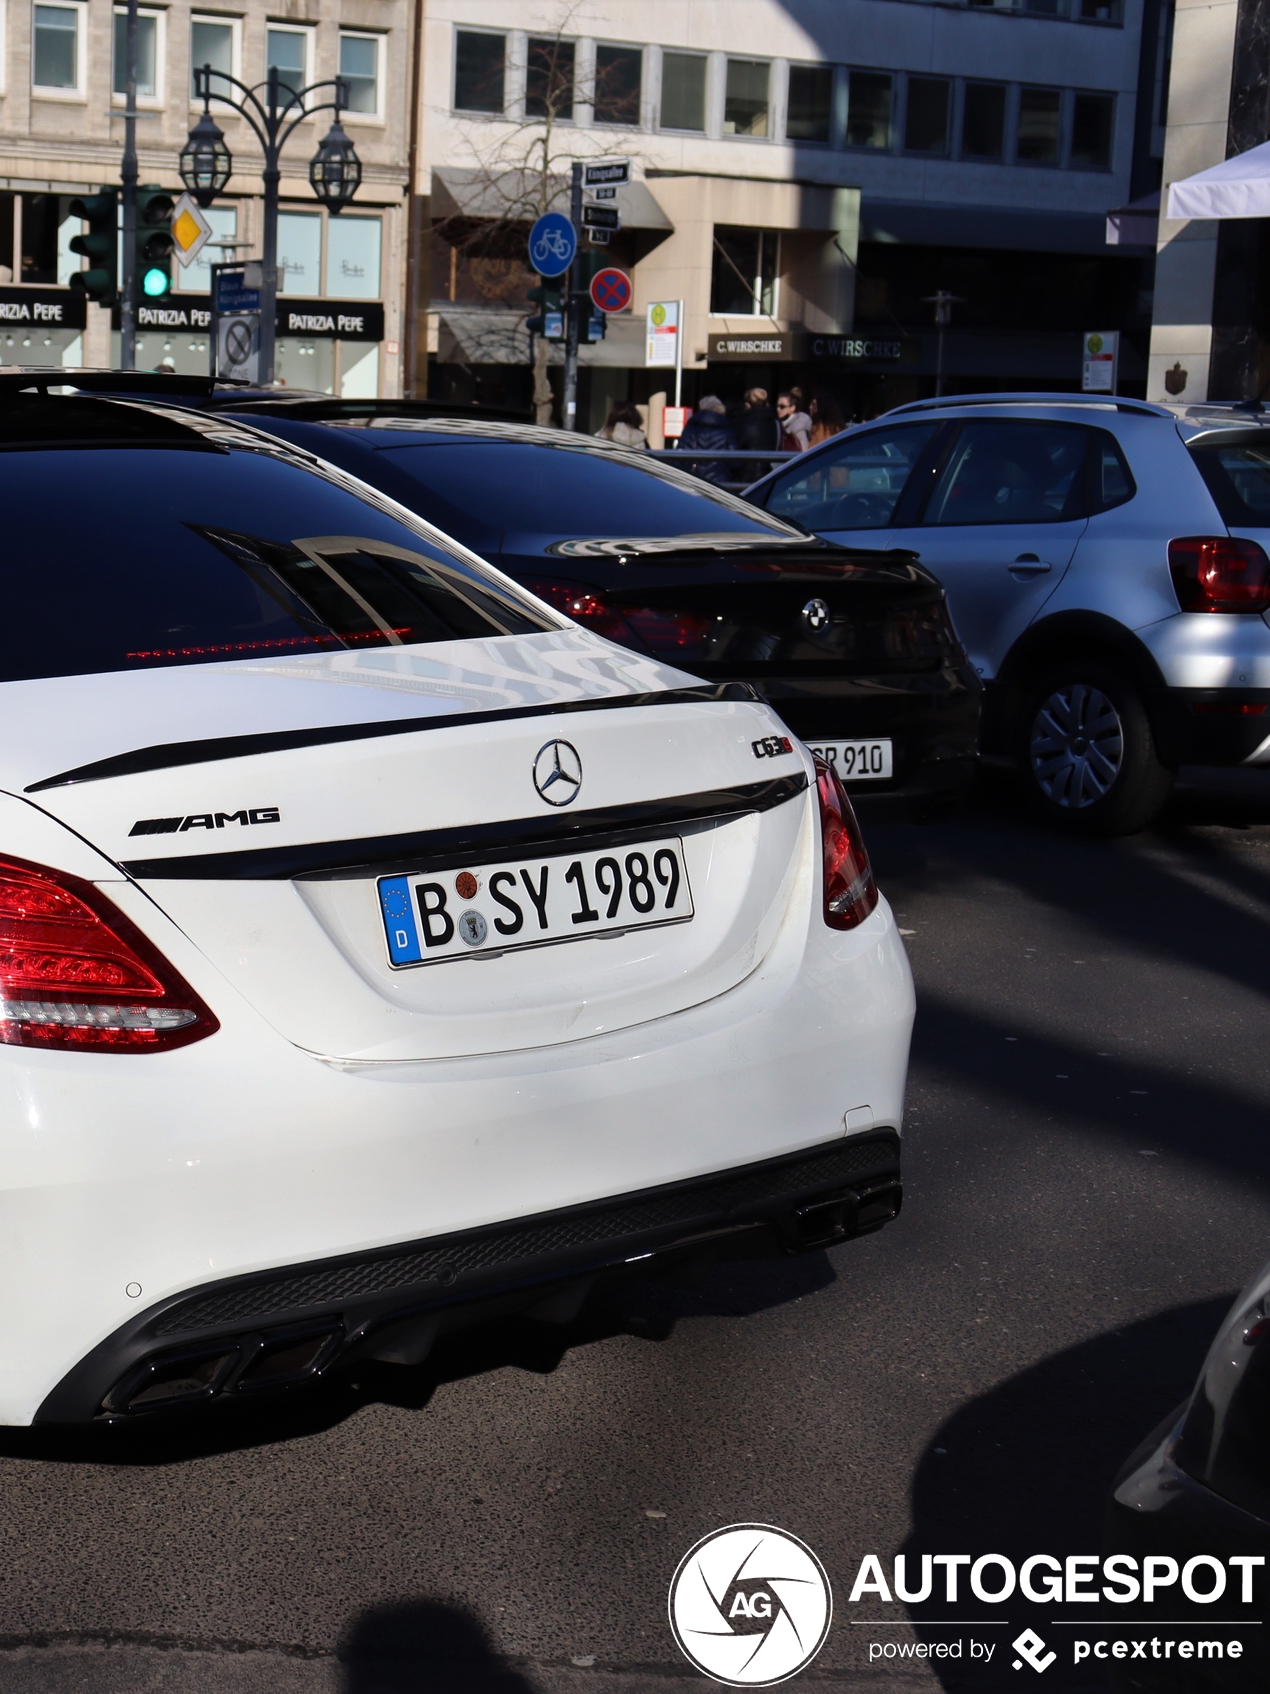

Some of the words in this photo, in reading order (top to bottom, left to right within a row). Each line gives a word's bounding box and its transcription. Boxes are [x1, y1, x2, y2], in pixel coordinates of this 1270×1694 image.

[33, 302, 63, 321] PEPE
[138, 307, 188, 325] PATRIZIA
[191, 309, 213, 327] PEP
[288, 313, 336, 331] PATRIZIA
[337, 314, 364, 332] PEPE
[716, 340, 782, 353] C.WIRSCHKE
[843, 745, 883, 775] 910
[179, 807, 281, 832] AMG
[395, 929, 409, 949] D
[415, 882, 455, 948] B
[488, 865, 549, 935] SY
[564, 848, 680, 924] 1989
